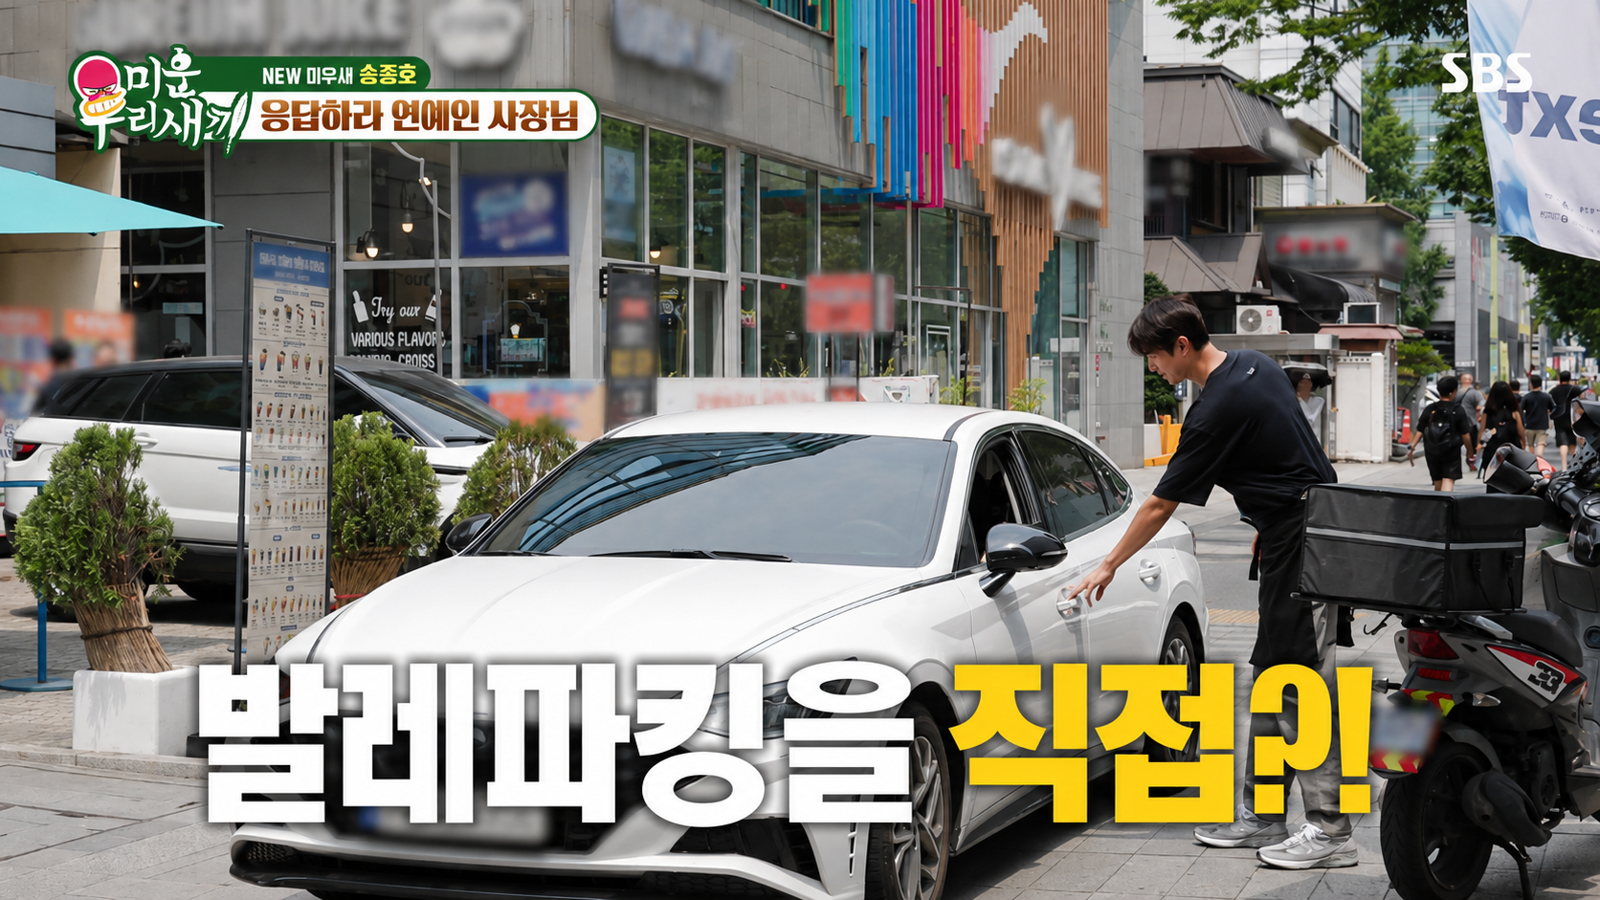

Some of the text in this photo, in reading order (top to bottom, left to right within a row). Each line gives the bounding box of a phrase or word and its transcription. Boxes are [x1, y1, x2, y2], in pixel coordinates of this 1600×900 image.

[371, 296, 421, 324] Try our
[351, 331, 395, 347] VARIOUS
